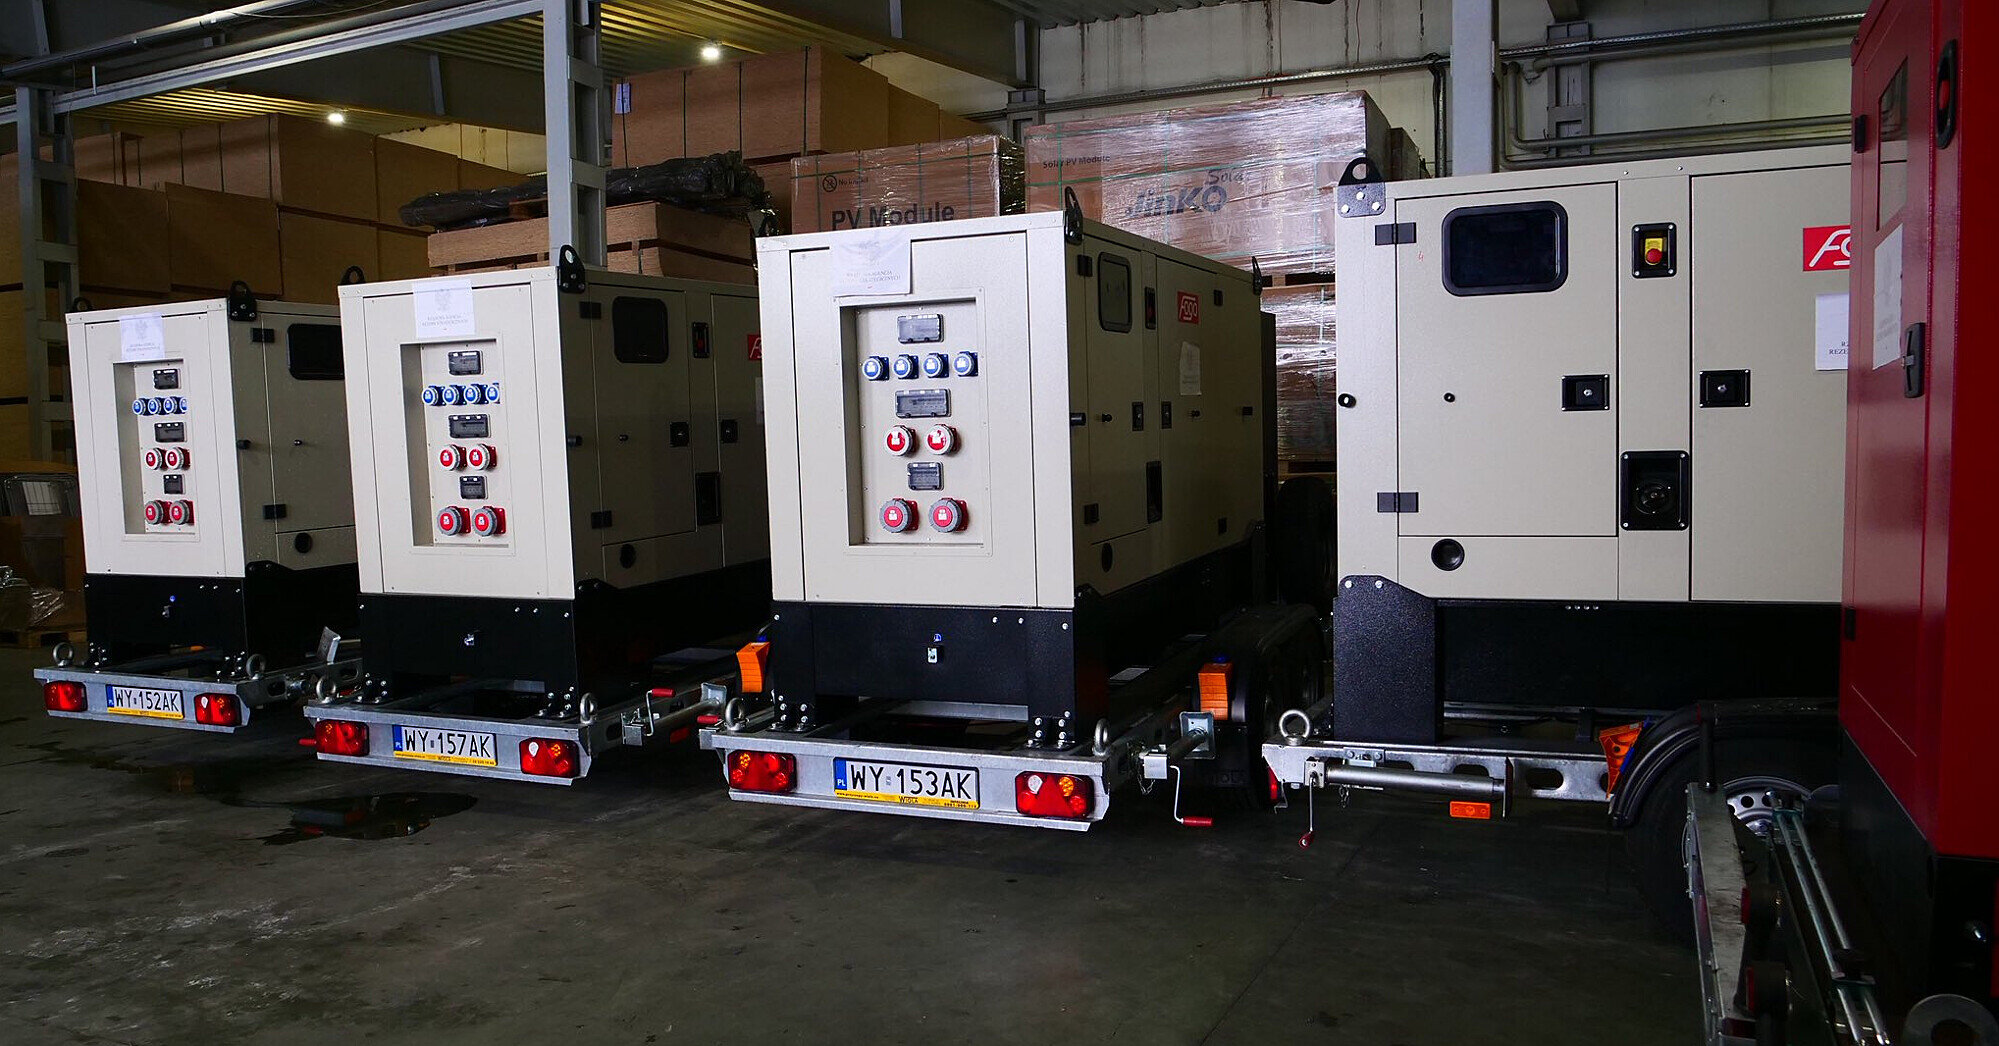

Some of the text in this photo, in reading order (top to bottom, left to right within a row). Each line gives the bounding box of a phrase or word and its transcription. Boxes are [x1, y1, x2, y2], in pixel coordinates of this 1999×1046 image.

[831, 201, 956, 231] PV Module
[114, 688, 179, 712] WY 152AK
[404, 729, 491, 758] WY 157AK
[837, 778, 846, 786] PL
[850, 764, 972, 800] WY 153AK
